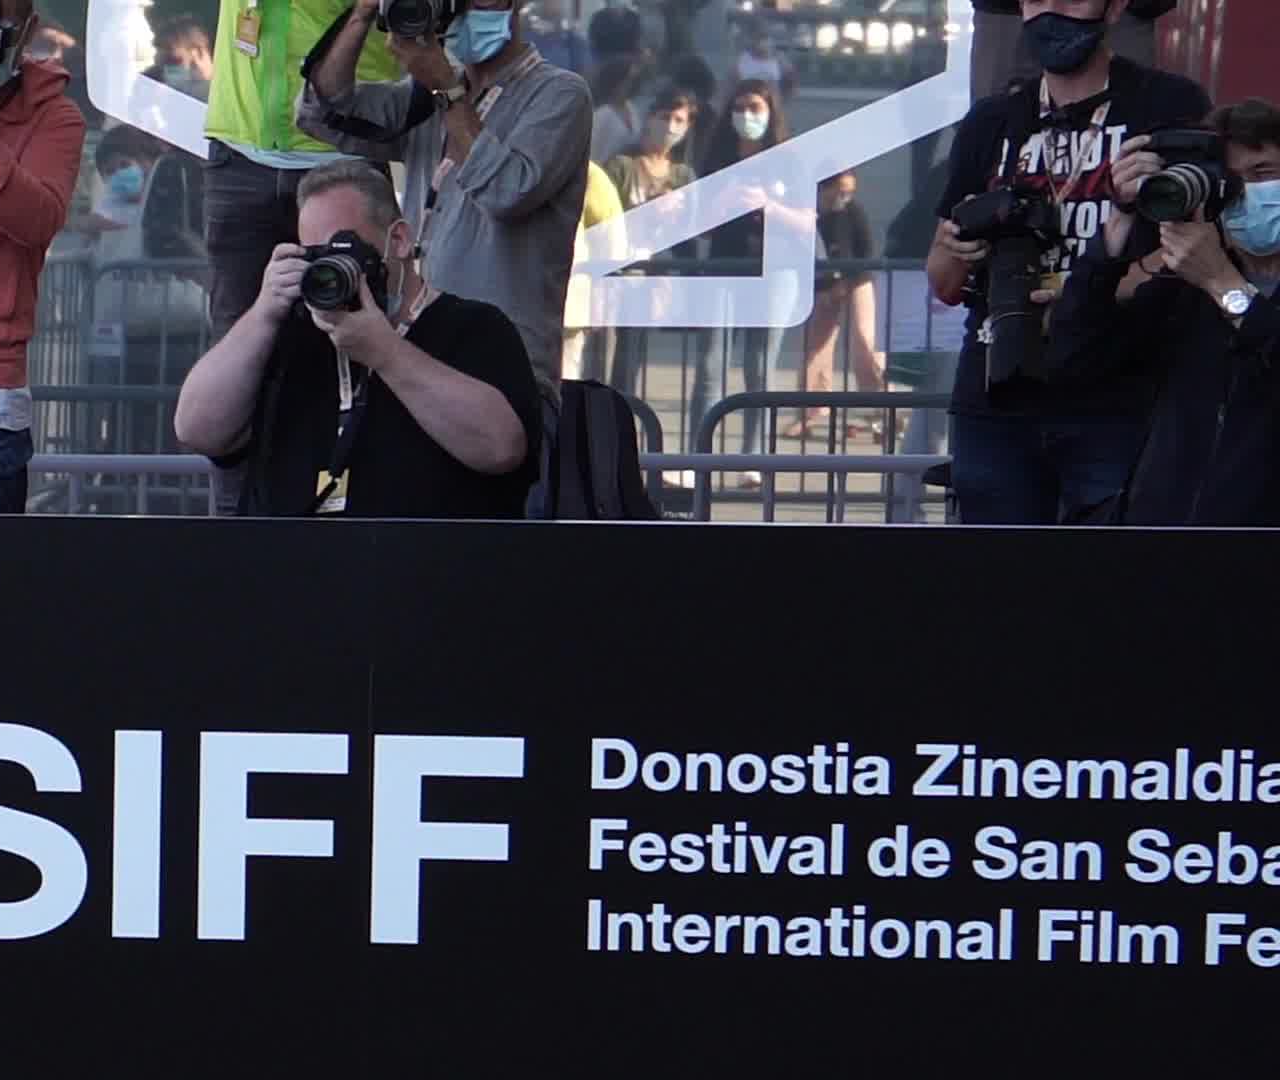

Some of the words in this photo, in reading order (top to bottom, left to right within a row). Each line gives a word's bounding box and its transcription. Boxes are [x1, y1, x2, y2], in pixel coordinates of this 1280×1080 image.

[590, 737, 890, 796] Donostia
[912, 743, 1280, 803] Zinemaldia
[589, 818, 845, 876] Festival
[867, 825, 951, 878] de
[972, 825, 1102, 881] San
[587, 899, 1013, 961] International
[1037, 909, 1179, 964] Film
[1204, 913, 1280, 967] Fe
